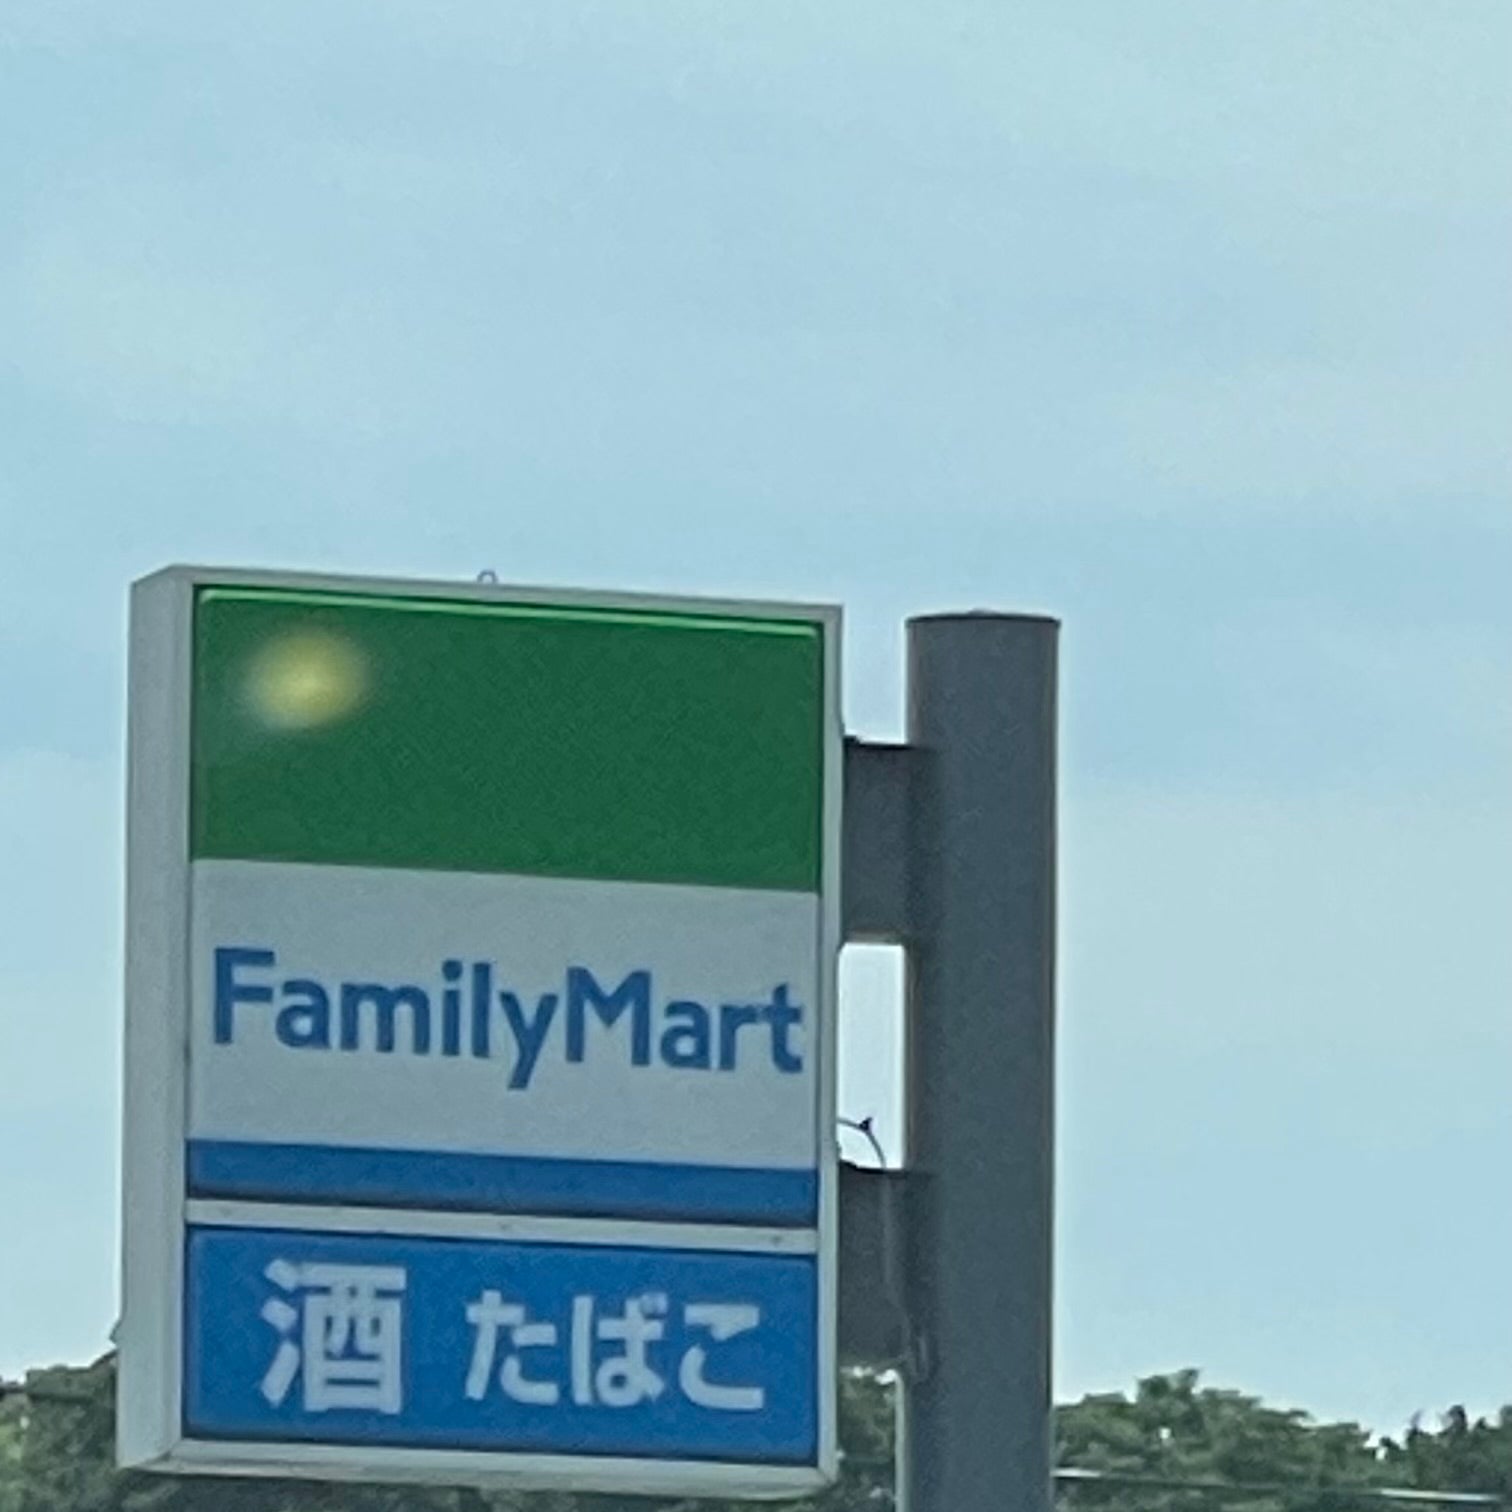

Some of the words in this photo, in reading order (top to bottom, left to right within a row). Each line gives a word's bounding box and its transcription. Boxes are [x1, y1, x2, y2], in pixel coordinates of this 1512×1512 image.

[212, 946, 804, 1090] FamilyMart
[260, 1257, 408, 1415] 酒
[464, 1289, 765, 1411] たばこ
